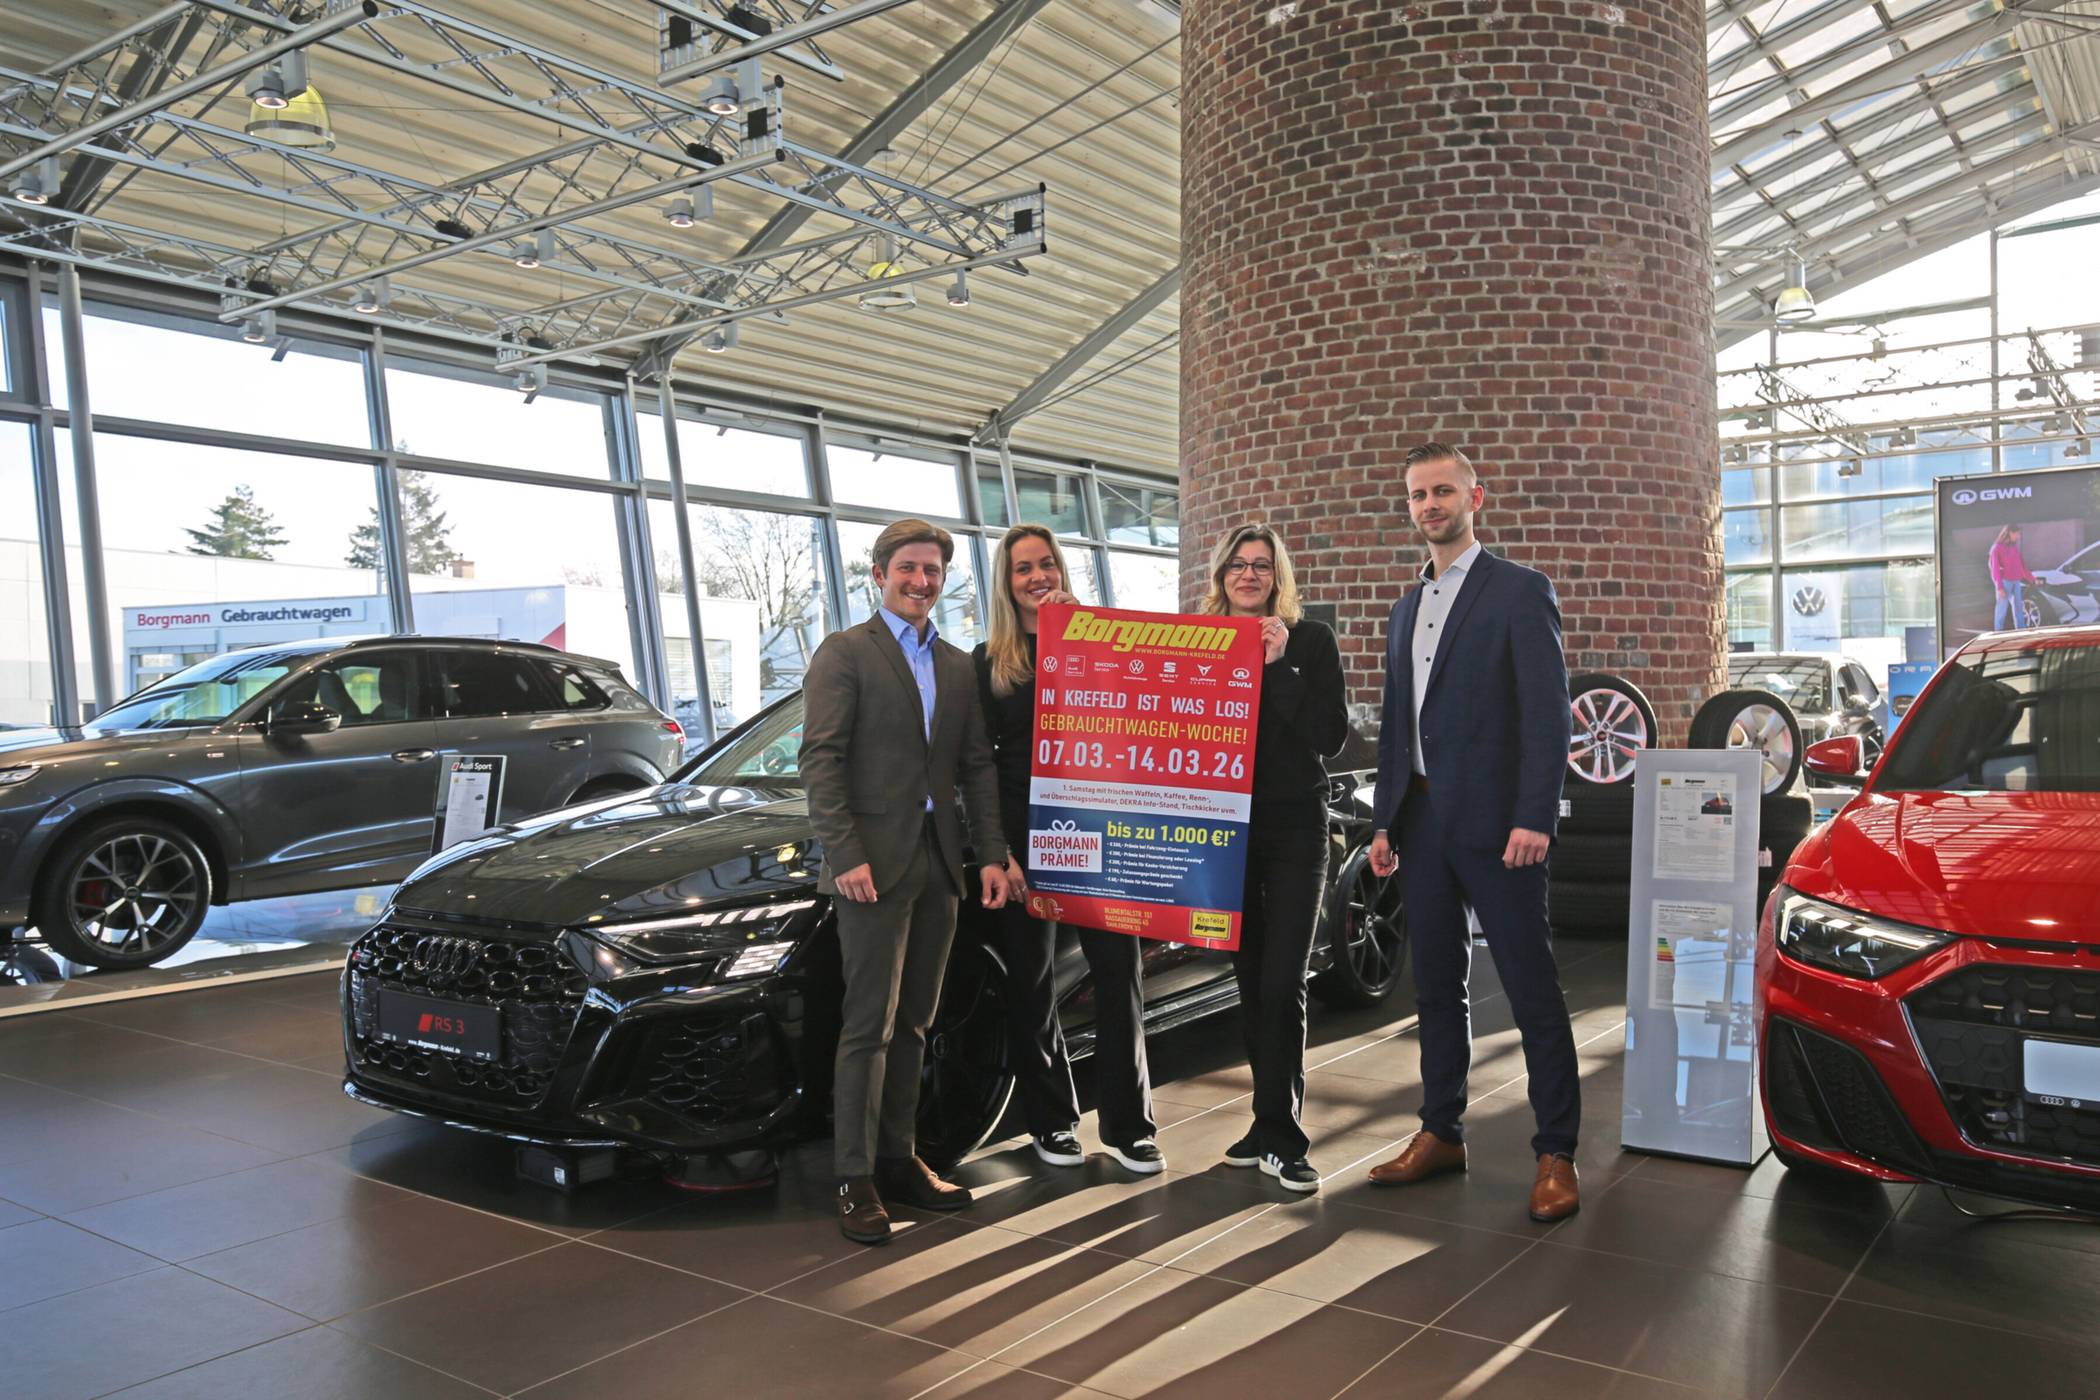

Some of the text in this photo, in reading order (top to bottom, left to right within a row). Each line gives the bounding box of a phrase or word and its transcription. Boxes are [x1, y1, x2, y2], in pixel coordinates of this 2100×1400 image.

[1980, 486, 2032, 500] GWM
[137, 606, 352, 628] Borgmann Gebrauchtwagen
[1062, 611, 1238, 652] Borgmann
[1228, 680, 1253, 688] GWM
[1042, 688, 1250, 720] IN KREFELD IST WAS LOS!
[1040, 713, 1248, 745] GEBRAUCHTWAGEN-WOCHE!
[474, 762, 492, 770] Sport
[1068, 785, 1096, 794] Samstag
[1108, 788, 1133, 796] frischen
[1134, 790, 1162, 799] Waffeln,
[1164, 793, 1188, 801] Kaffee,
[1120, 798, 1142, 806] DEKRA
[1143, 802, 1180, 810] Info-Stand,
[1182, 804, 1220, 812] Tischkicker
[1106, 820, 1132, 838] bis
[1135, 827, 1156, 840] zu
[1160, 825, 1208, 844] 1.000
[1032, 835, 1098, 850] BORGMANN
[1040, 850, 1088, 868] PRÄMIE!
[434, 1016, 464, 1036] RS 3
